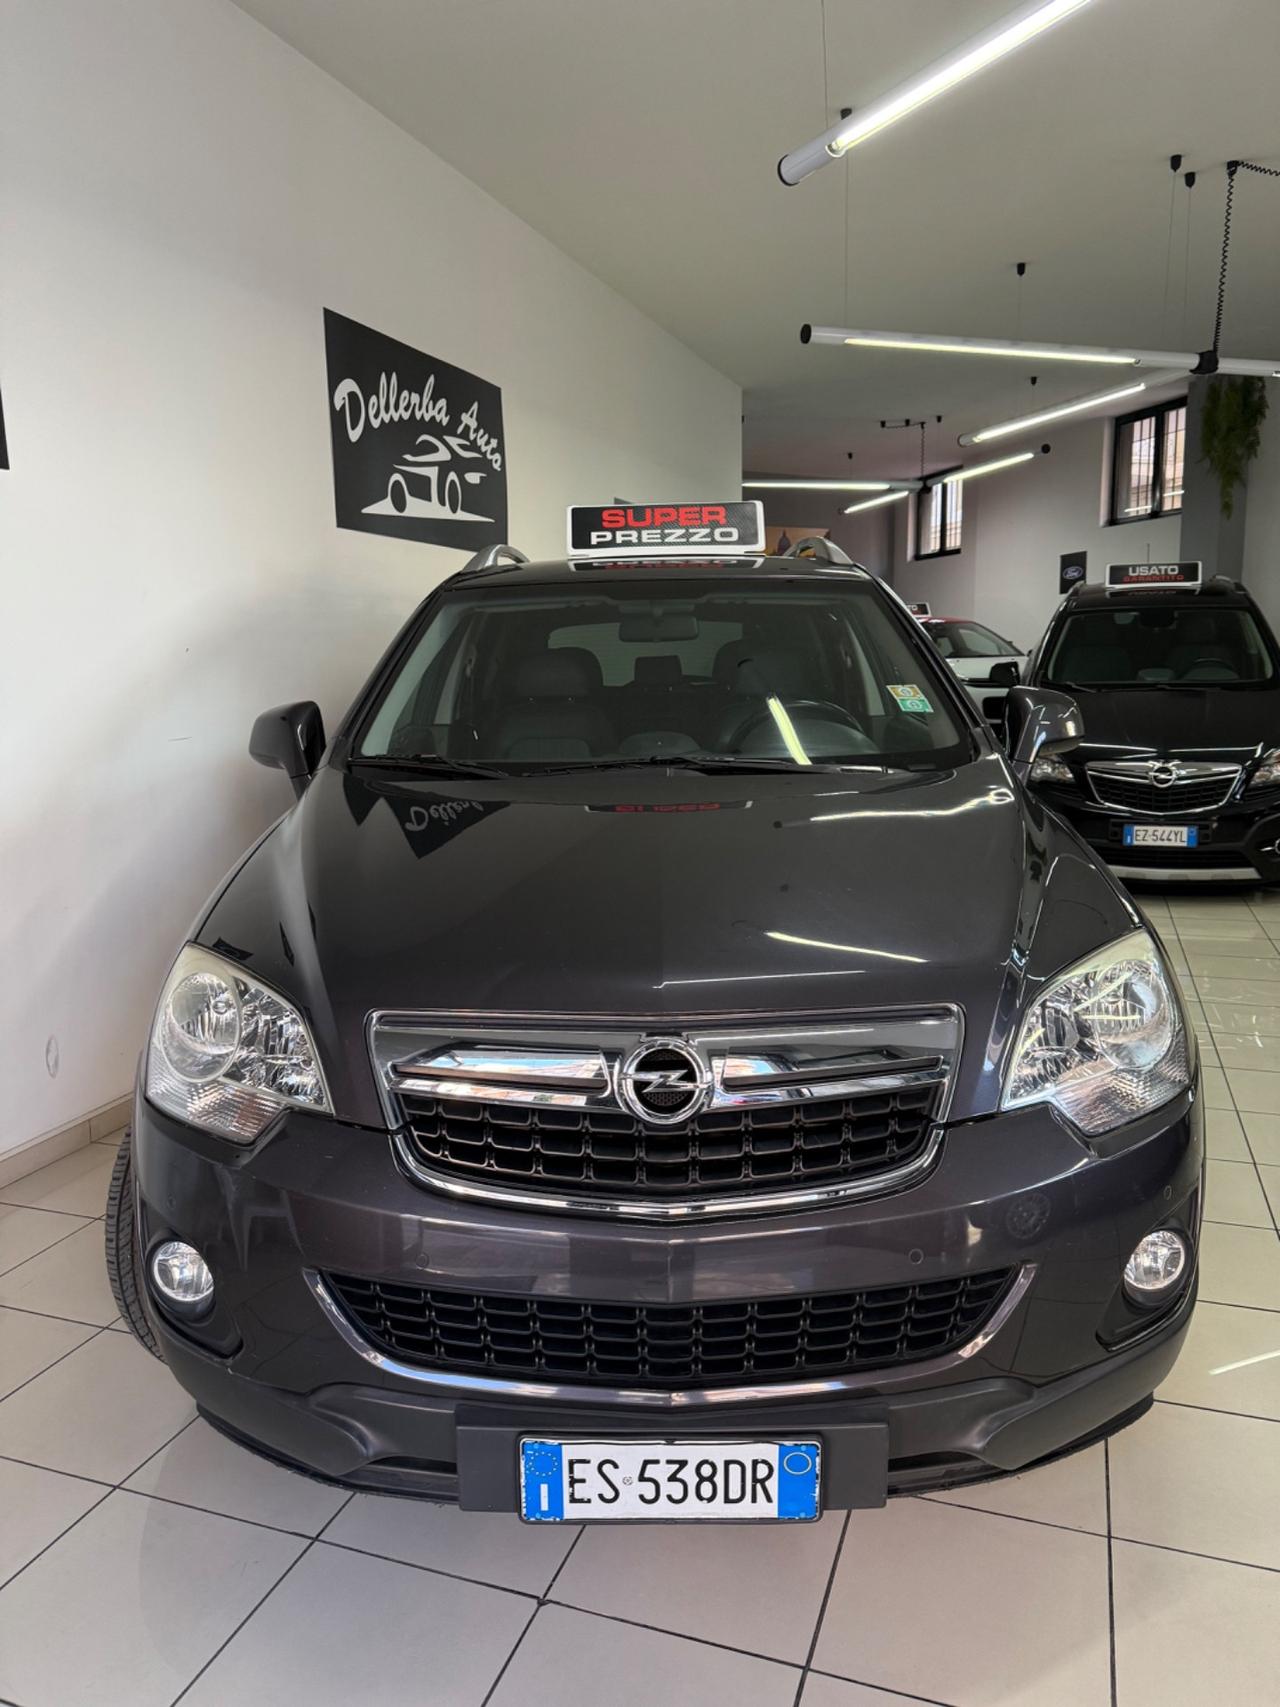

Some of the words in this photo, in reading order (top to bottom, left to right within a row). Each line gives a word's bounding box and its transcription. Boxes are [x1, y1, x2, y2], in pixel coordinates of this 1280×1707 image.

[334, 372, 449, 442] Dellerba
[457, 401, 502, 471] Auto
[602, 506, 726, 528] SUPER
[590, 528, 739, 545] PREZZO
[1128, 565, 1179, 576] USATO
[568, 1459, 620, 1504] ES
[638, 1459, 774, 1504] 538DR
